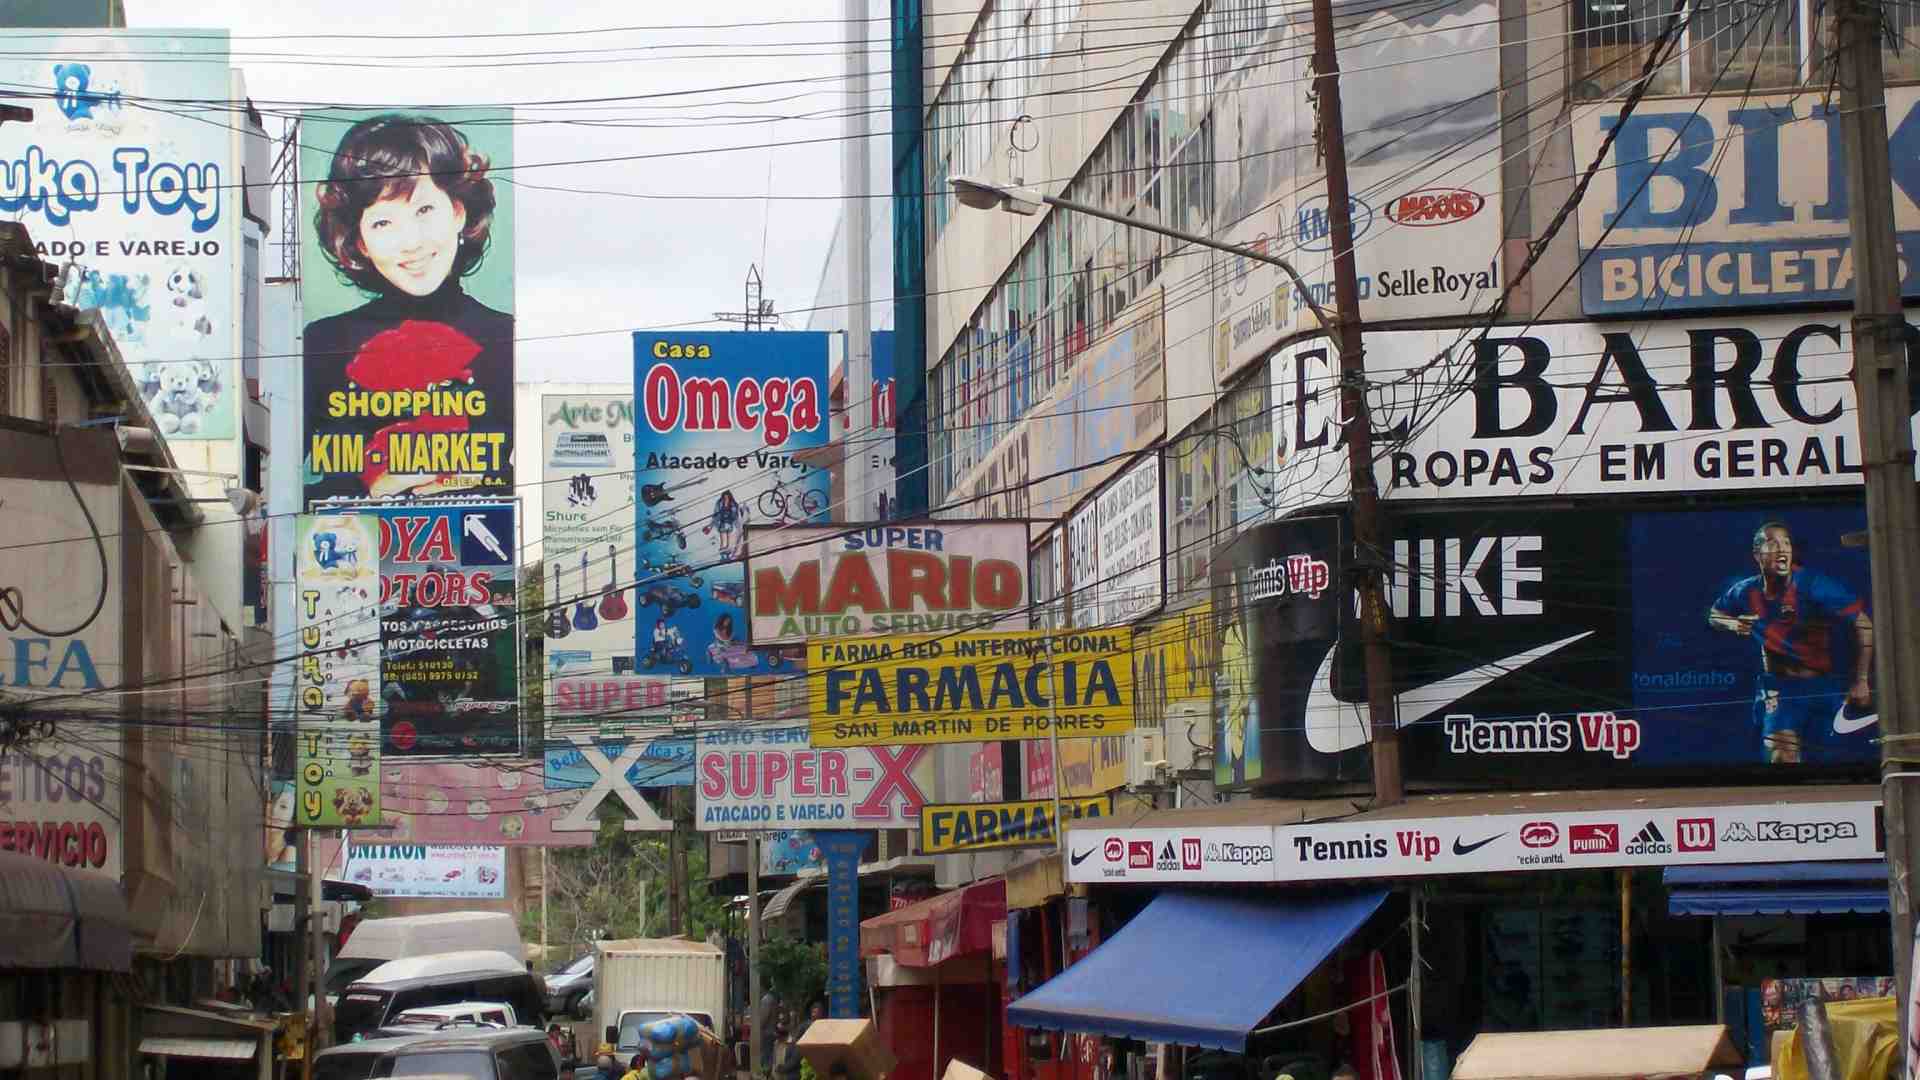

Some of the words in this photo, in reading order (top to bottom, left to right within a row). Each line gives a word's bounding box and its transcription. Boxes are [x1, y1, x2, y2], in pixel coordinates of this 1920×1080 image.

[113, 148, 220, 233] Toy
[96, 241, 110, 256] E
[120, 241, 220, 256] VAREJO
[1378, 269, 1429, 297] Selle
[1431, 259, 1497, 301] Royal
[654, 342, 711, 358] Casa
[1471, 323, 1920, 440] BARC
[328, 390, 487, 417] SHOPPING
[548, 400, 602, 428] Arte
[644, 363, 821, 446] Omega
[312, 434, 364, 473] KIM
[389, 433, 505, 473] MARKET
[646, 452, 730, 469] Atacado
[737, 455, 749, 469] e
[756, 452, 808, 472] Vare
[1392, 447, 1554, 488] ROPAS
[1600, 443, 1665, 481] EM
[1694, 435, 1866, 478] GERAL
[844, 526, 945, 550] SUPER
[754, 549, 1024, 616] MARIO
[1287, 554, 1329, 600] Vip
[779, 615, 860, 637] AUTO
[388, 638, 489, 650] MOTOCICLETAS
[821, 644, 884, 663] FARMA
[904, 640, 943, 659] RED
[954, 634, 1121, 659] INTERNACIONAL
[0, 637, 104, 689] FA
[557, 681, 666, 713] SUPER
[825, 659, 1122, 716] FARMACIA
[833, 722, 878, 740] SAN
[893, 717, 973, 738] MARTIN
[986, 716, 1011, 733] DE
[1024, 713, 1105, 732] PORRES
[1445, 714, 1572, 753] Tennis
[1577, 712, 1641, 758] Vip
[702, 745, 930, 819] SUPER-X
[705, 806, 771, 823] ATACADO
[776, 804, 784, 820] E
[790, 803, 845, 820] VAREJO
[1294, 834, 1388, 861] Tennis
[1396, 831, 1441, 861] Vip
[1756, 820, 1857, 843] Kappa
[1221, 843, 1273, 865] Kappa
[1624, 841, 1672, 855] adidas
